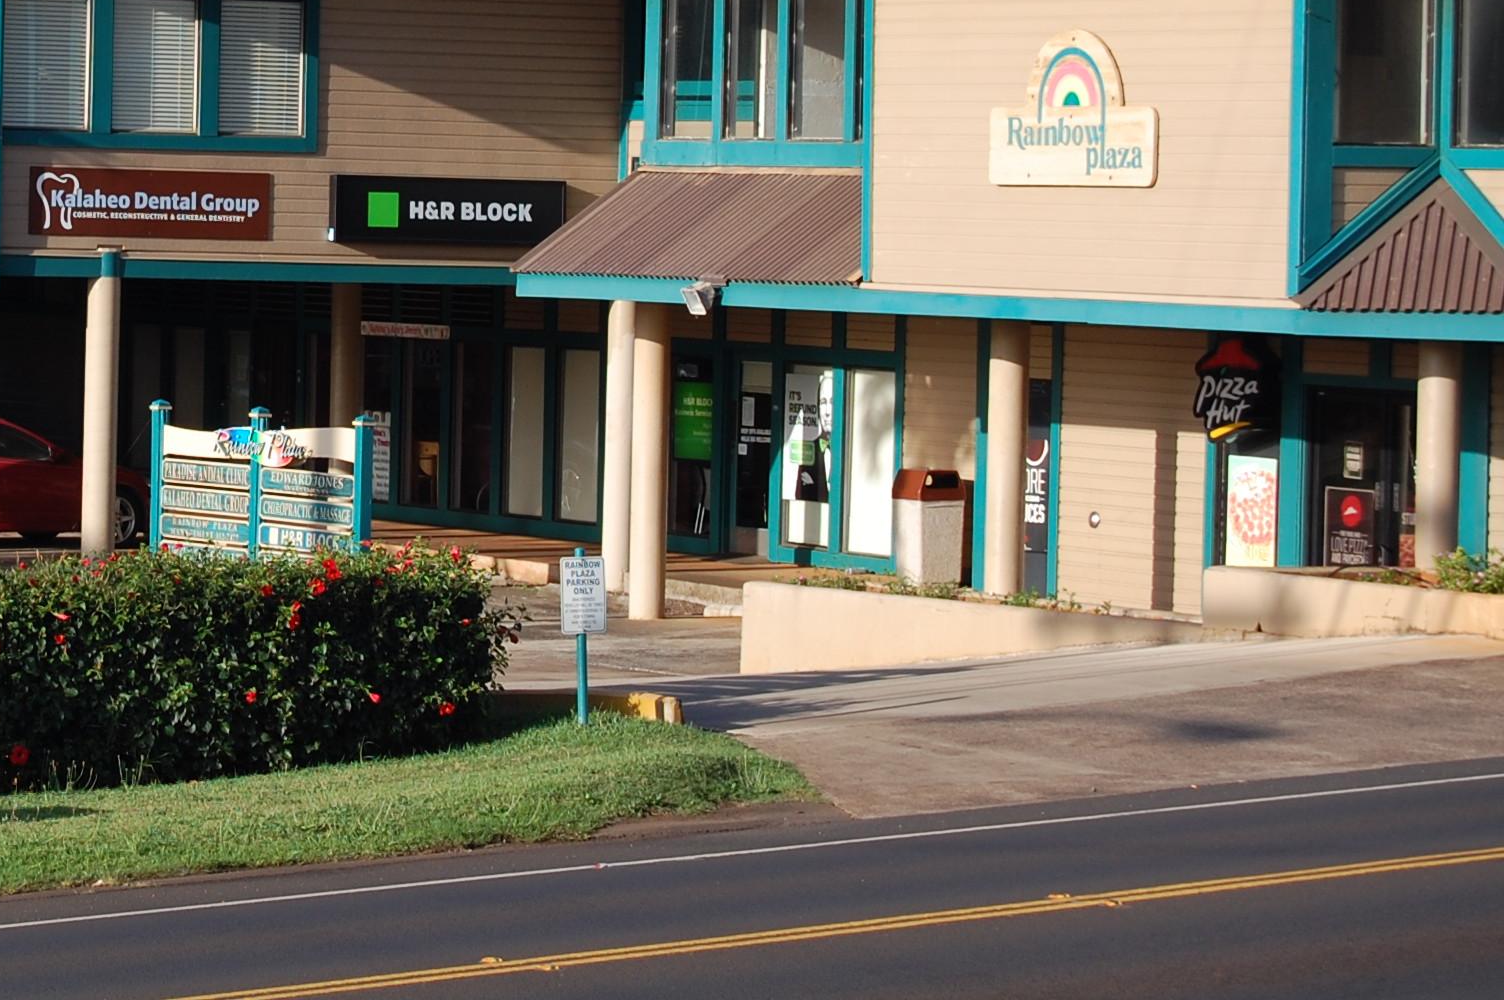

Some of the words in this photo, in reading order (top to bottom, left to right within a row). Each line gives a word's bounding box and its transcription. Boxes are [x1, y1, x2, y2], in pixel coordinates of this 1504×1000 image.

[1007, 116, 1105, 151] Rainbow
[1085, 144, 1143, 176] plaza
[51, 189, 130, 210] Kalaheo
[134, 190, 196, 211] Dental
[200, 193, 260, 217] Group
[409, 200, 455, 221] H&R
[460, 202, 533, 223] BLOCK
[176, 213, 207, 222] GENERAL
[208, 214, 245, 223] DENTISTRY
[789, 391, 802, 401] IT'S
[788, 402, 818, 414] REFUND
[1205, 402, 1251, 429] Hut
[164, 462, 197, 481] PARADISE
[198, 466, 224, 483] ANIMAL
[226, 469, 249, 486] CLINIC
[271, 471, 312, 487] EDWARD
[312, 476, 344, 490] JONES
[163, 489, 195, 508] KALAHEO
[196, 492, 222, 510] DENTAL
[224, 495, 249, 514] GROUP
[263, 500, 312, 519] CHIROPRACTIC
[320, 508, 351, 524] MASSAGE
[281, 529, 303, 548] H&R
[565, 560, 601, 569] RAINBOW
[571, 569, 595, 578] PLAZA
[566, 578, 600, 586] PARKING
[573, 587, 594, 595] ONLY
